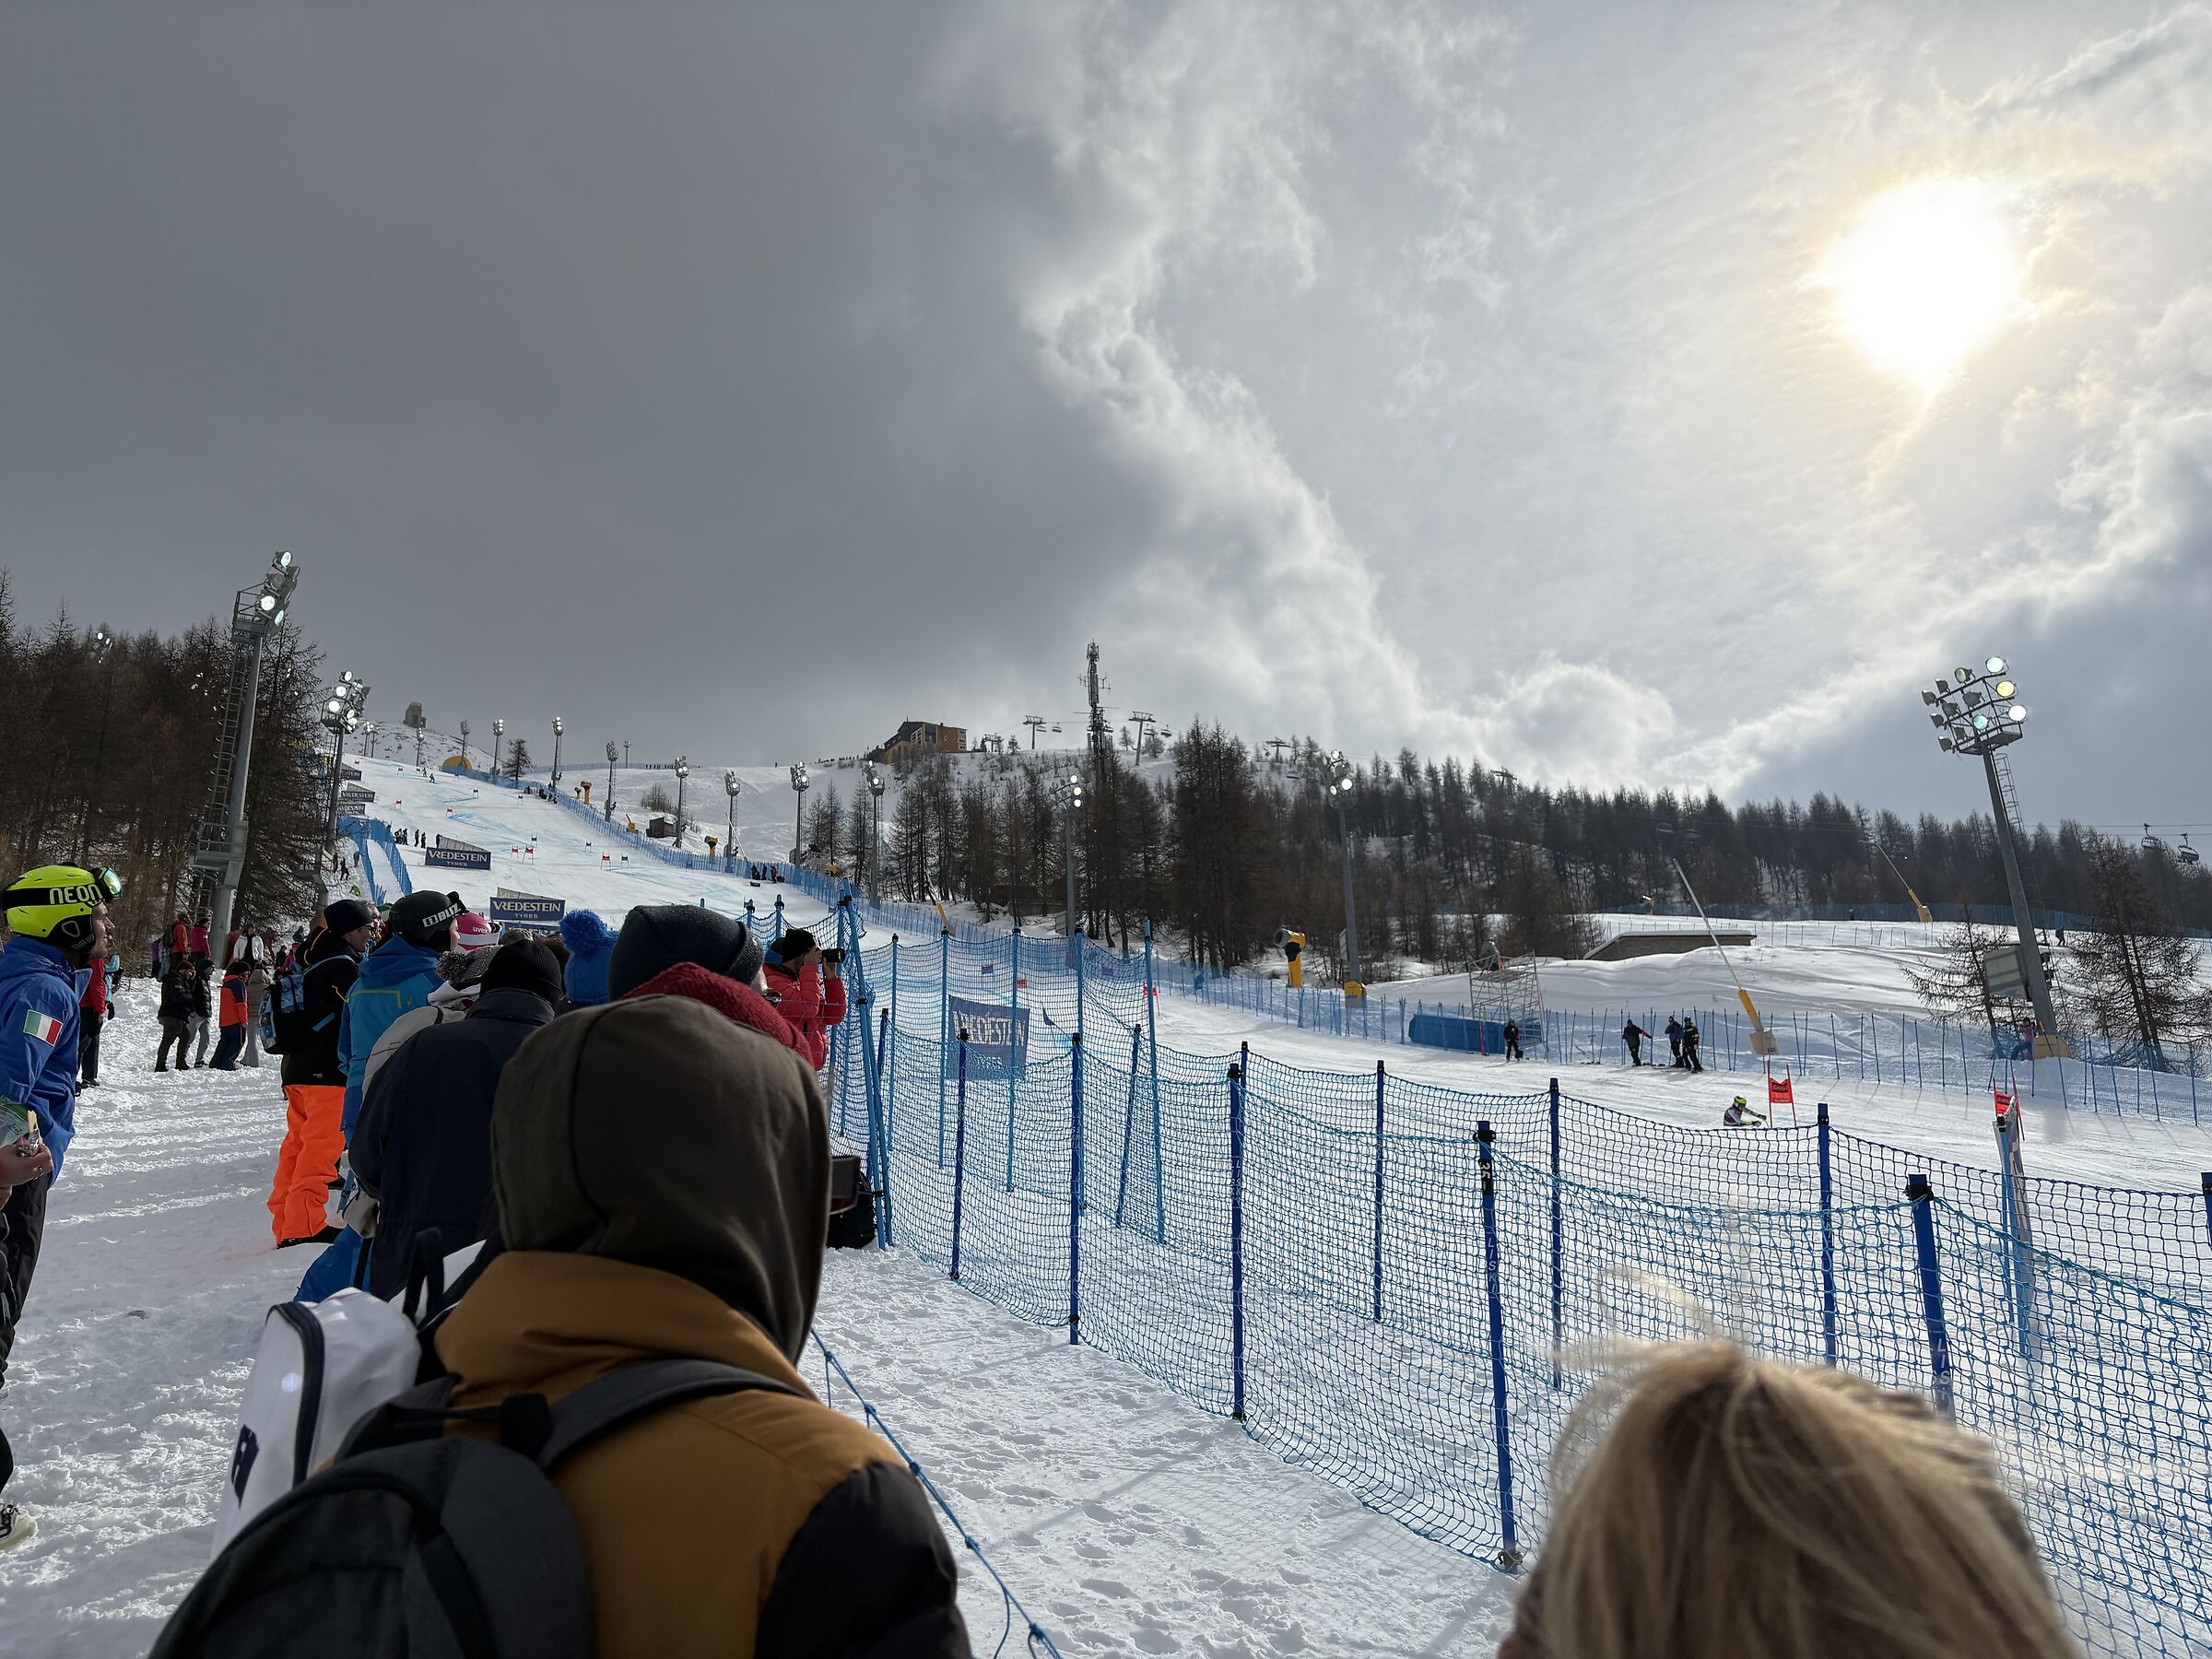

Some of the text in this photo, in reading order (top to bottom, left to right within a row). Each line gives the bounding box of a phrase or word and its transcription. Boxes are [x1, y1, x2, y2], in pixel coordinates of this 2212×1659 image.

[428, 850, 488, 863] VREDESTEIN
[492, 900, 561, 912] VREDESTEIN
[472, 926, 488, 935] uvex
